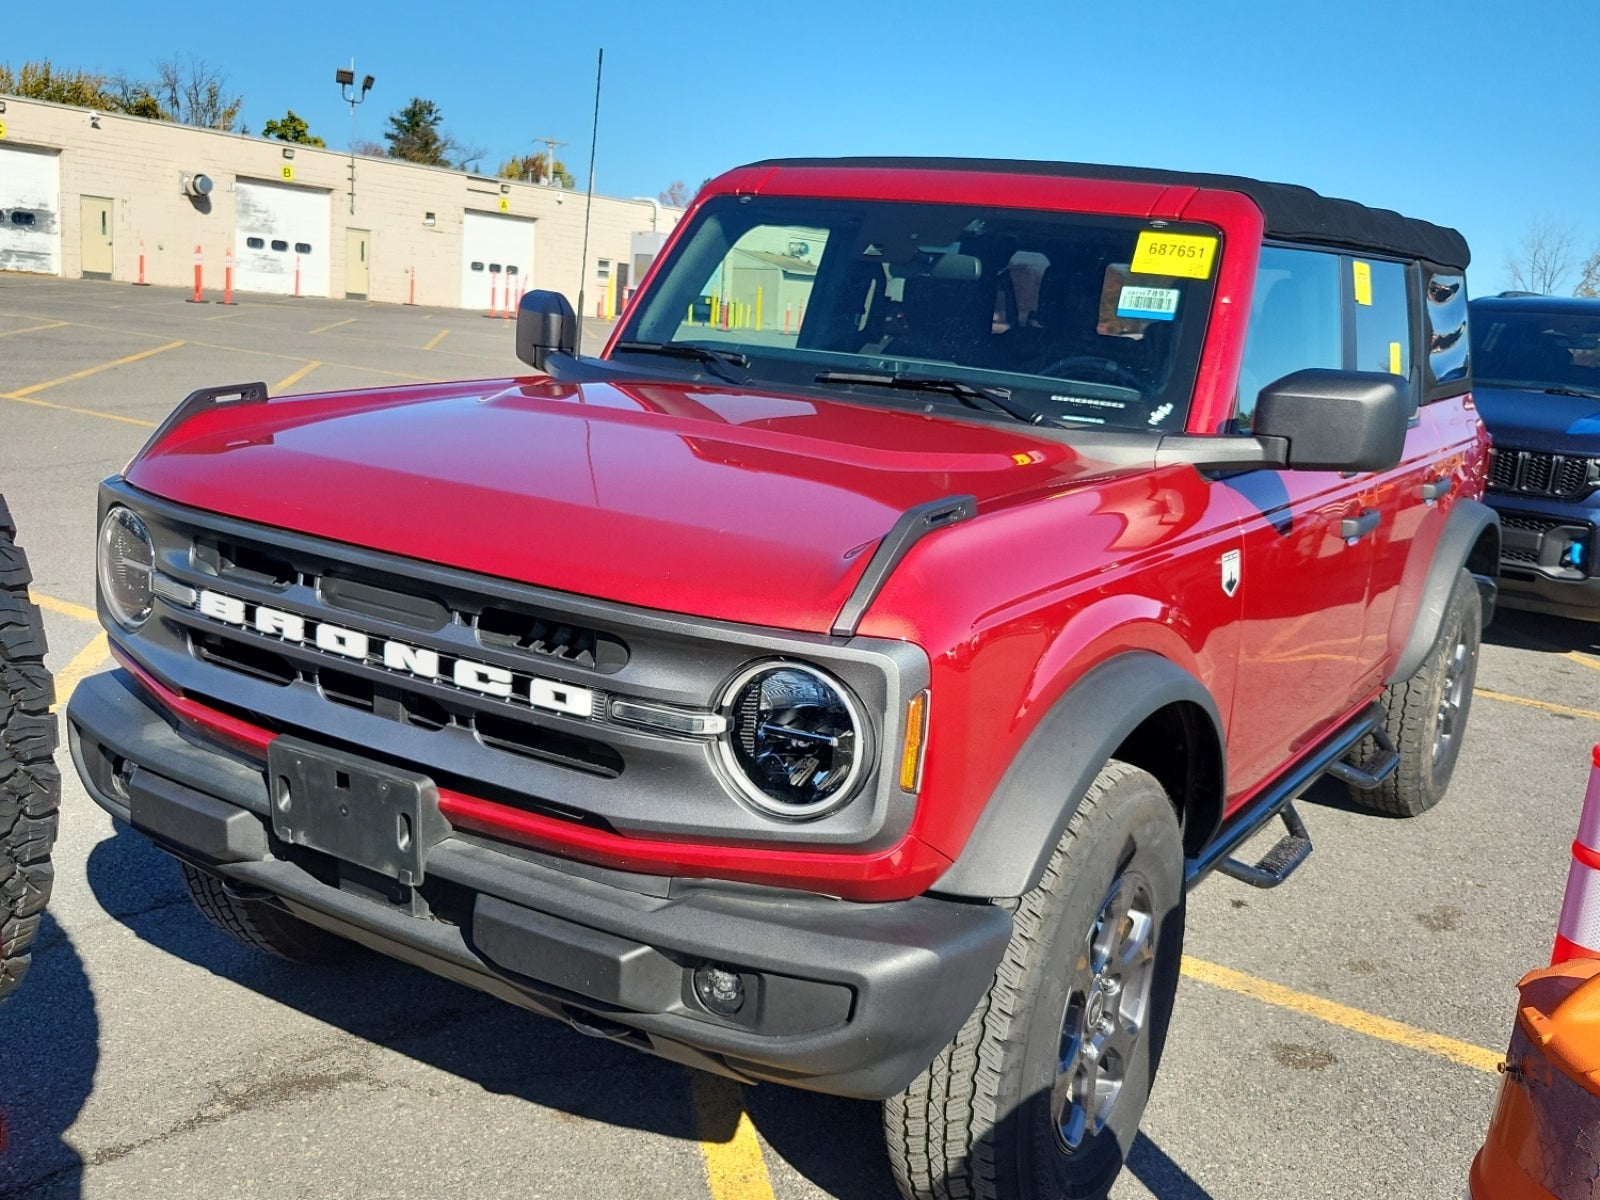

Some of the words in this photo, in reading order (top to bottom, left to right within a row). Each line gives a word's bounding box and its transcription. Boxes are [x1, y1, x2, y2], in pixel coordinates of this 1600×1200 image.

[283, 167, 291, 177] B
[1149, 242, 1205, 258] 687651
[200, 590, 593, 717] BRONCO
